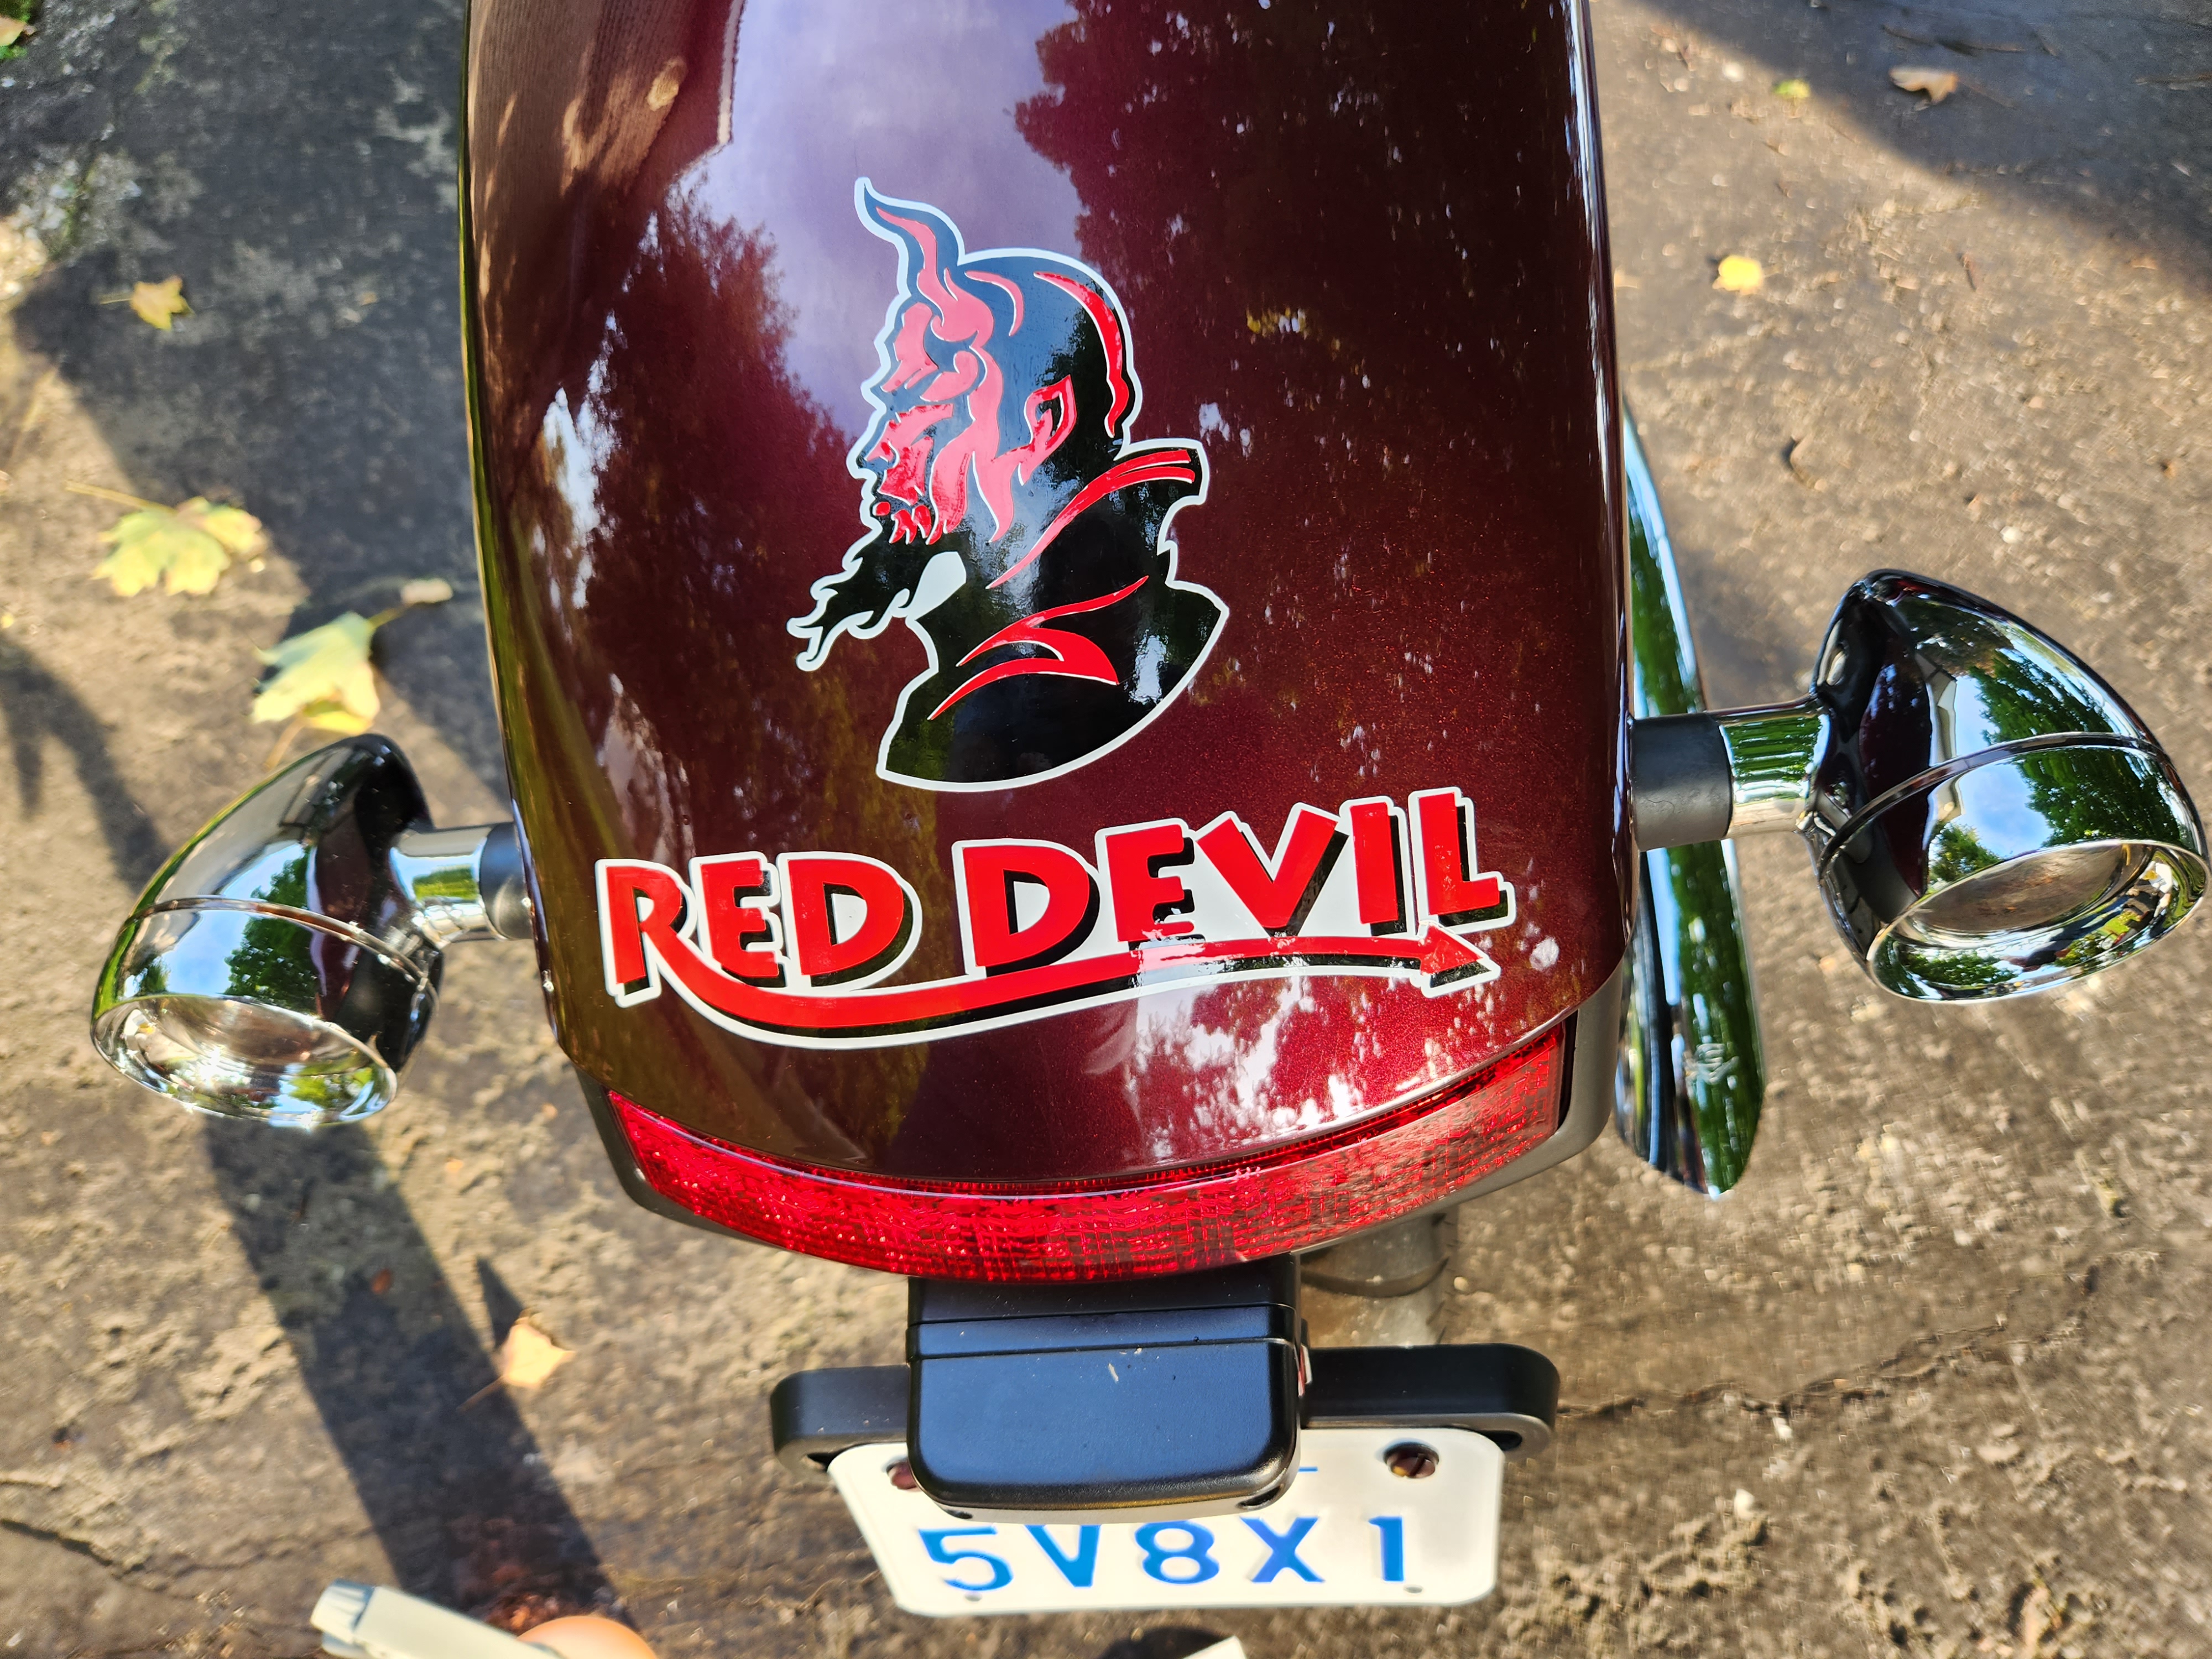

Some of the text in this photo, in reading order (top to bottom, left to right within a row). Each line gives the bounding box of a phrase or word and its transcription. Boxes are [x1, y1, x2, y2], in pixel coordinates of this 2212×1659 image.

[597, 788, 1515, 1003] RED DEVIL
[918, 1516, 1405, 1592] 5V8X1
